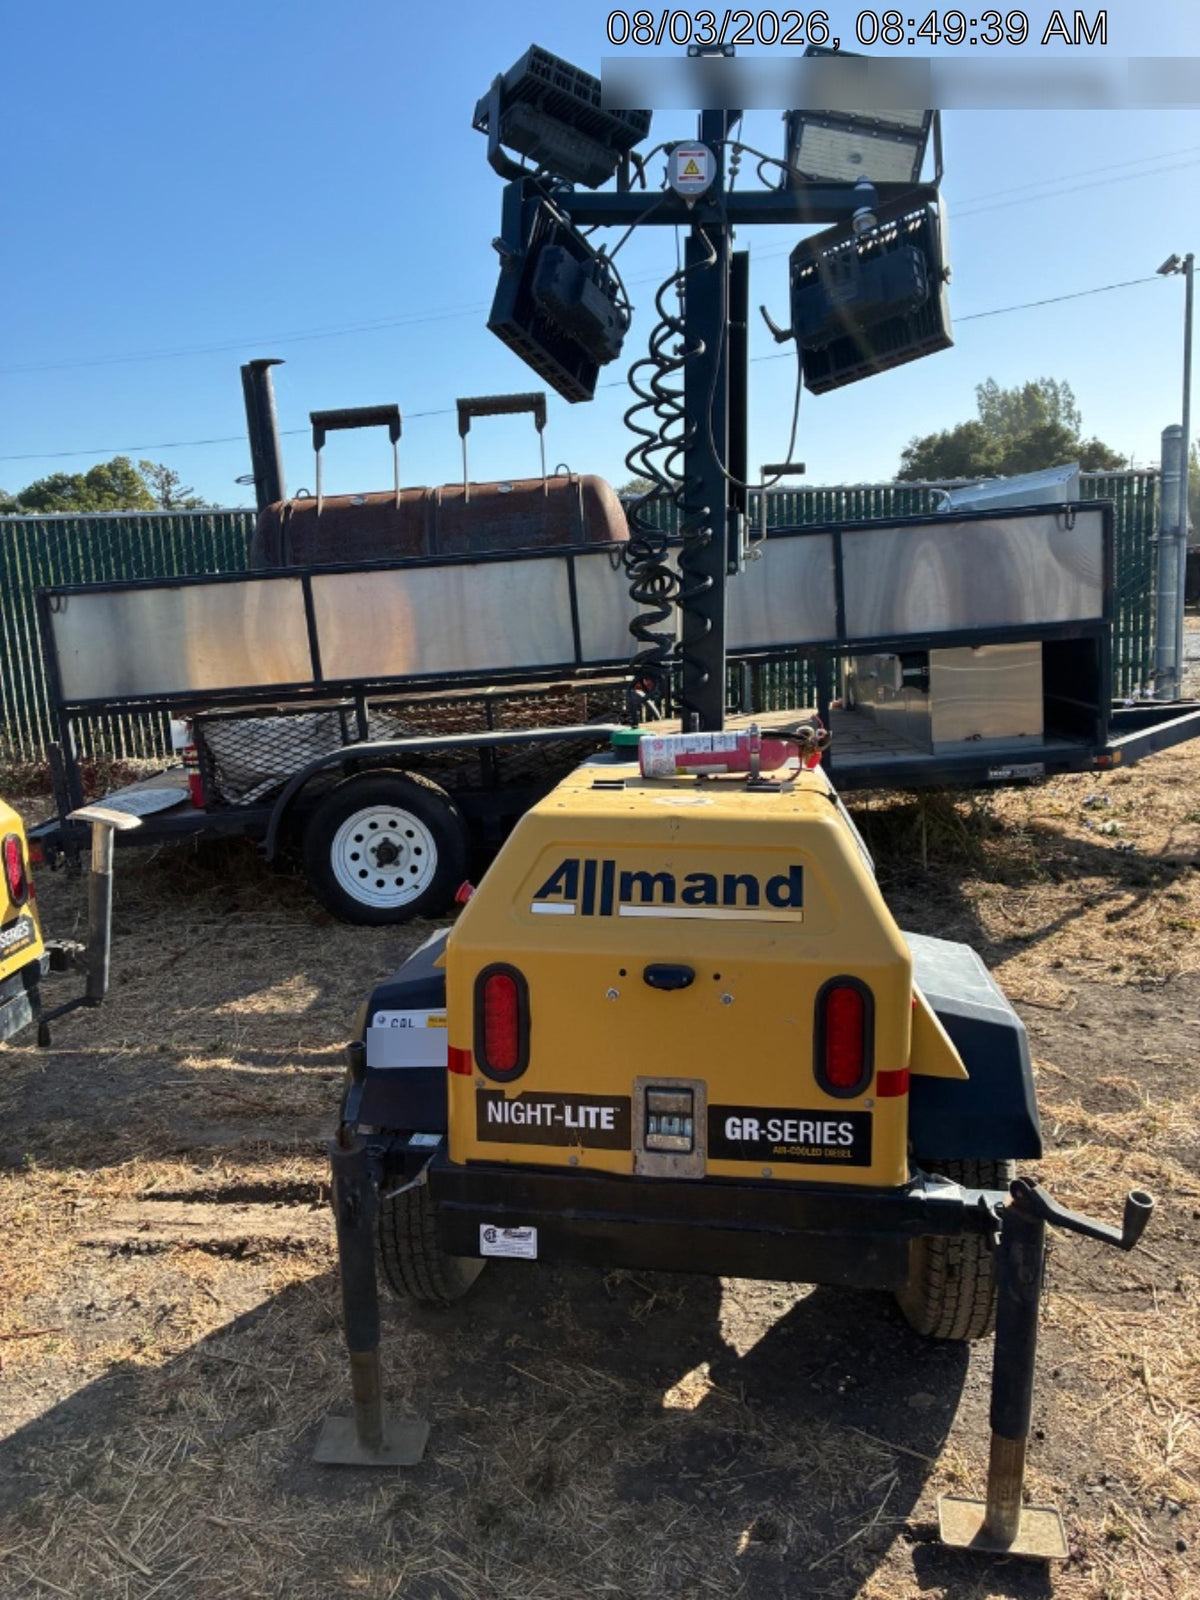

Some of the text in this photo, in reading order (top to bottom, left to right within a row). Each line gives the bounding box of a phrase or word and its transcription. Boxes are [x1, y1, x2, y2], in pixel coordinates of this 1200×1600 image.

[532, 858, 803, 917] Allmand
[487, 1100, 615, 1130] NIGHT-LITE
[725, 1116, 854, 1146] GR-SERIES
